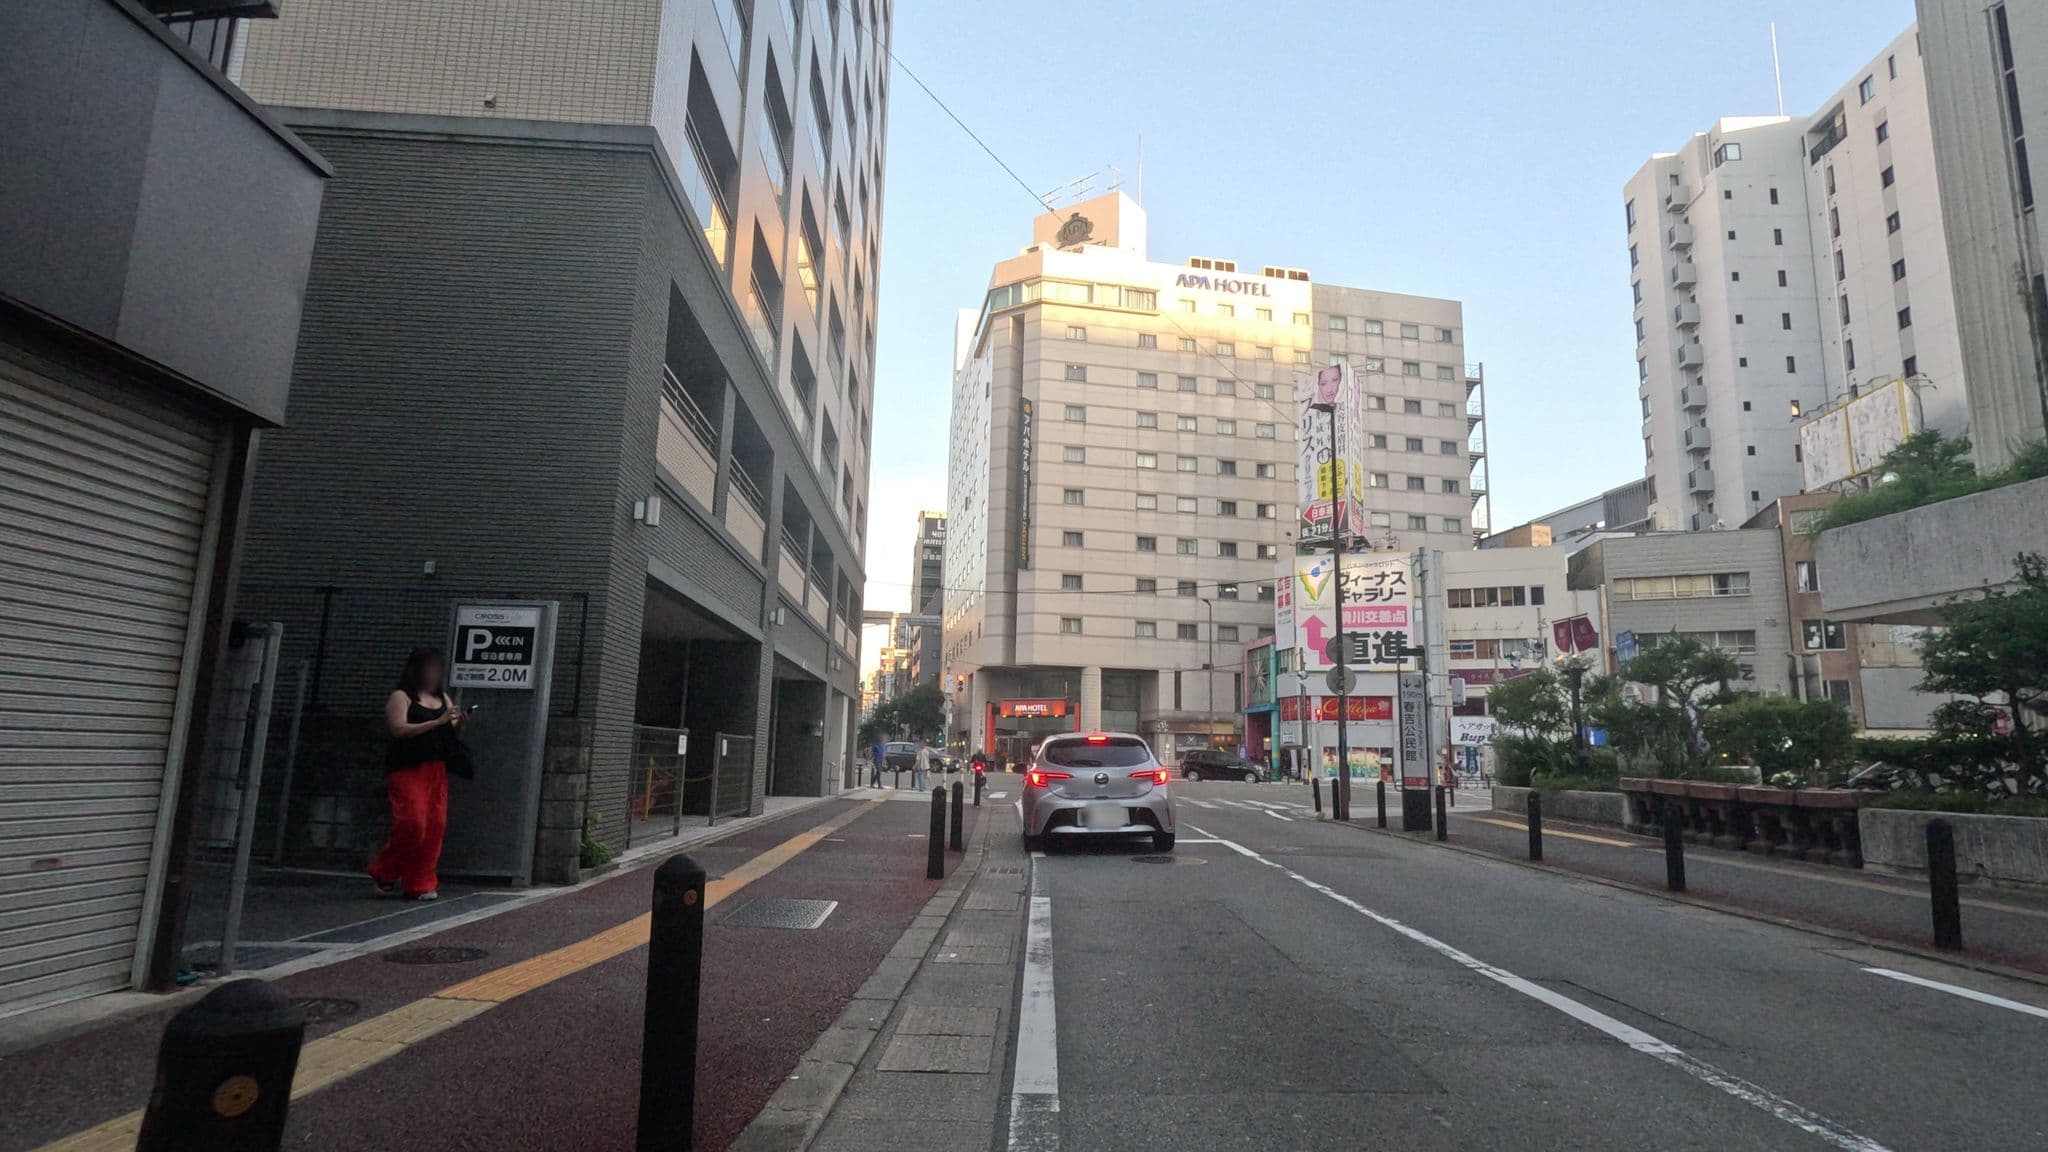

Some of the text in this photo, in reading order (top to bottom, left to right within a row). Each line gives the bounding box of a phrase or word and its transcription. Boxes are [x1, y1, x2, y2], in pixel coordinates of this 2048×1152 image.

[1176, 273, 1271, 297] APA HOTEL
[1022, 415, 1031, 472] アパホテル
[465, 628, 524, 661] P IN
[488, 668, 527, 682] 2.0M
[1028, 704, 1048, 712] HOTEL
[1404, 701, 1417, 762] 春吉公民館
[1460, 733, 1485, 743] Bup
